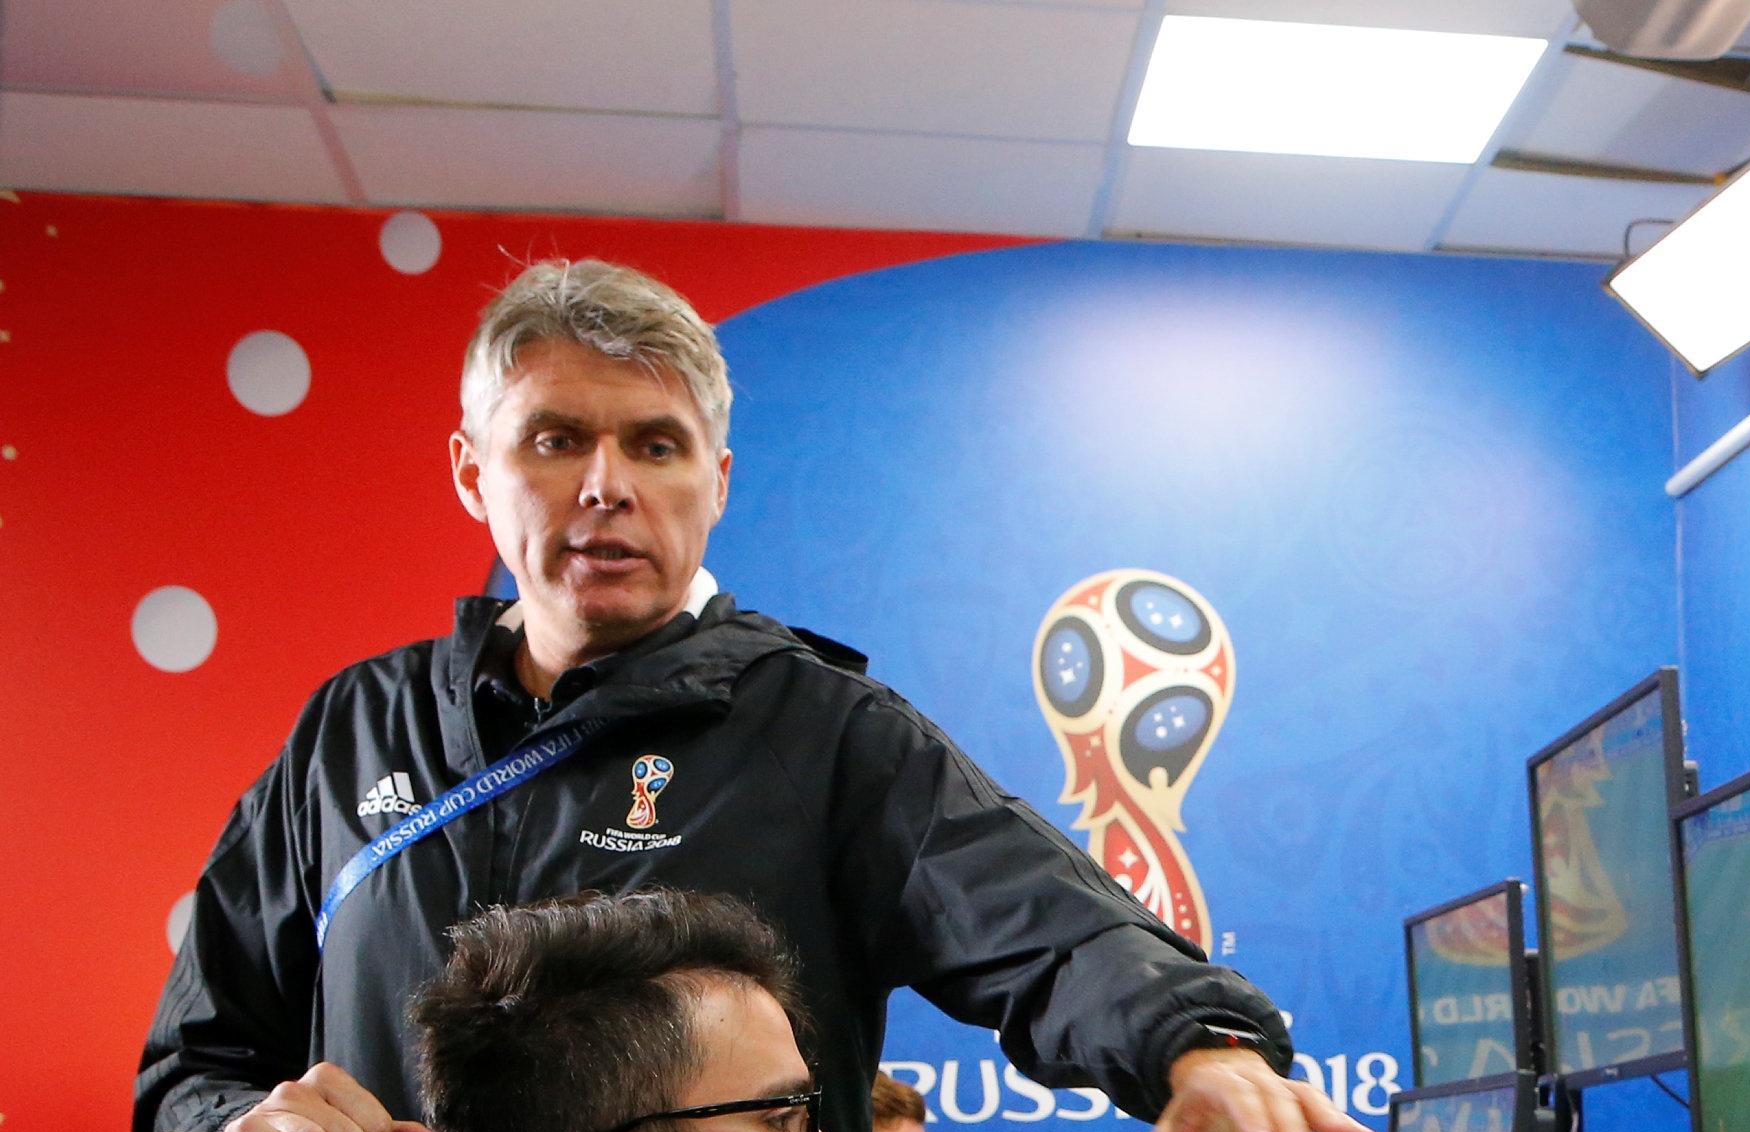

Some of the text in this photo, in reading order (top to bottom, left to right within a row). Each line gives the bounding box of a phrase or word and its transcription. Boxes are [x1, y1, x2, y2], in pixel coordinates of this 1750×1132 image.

[476, 749, 544, 794] WORLD
[357, 794, 423, 818] adidas
[440, 787, 476, 817] CUP
[372, 809, 437, 857] RUSSIA
[580, 830, 682, 853] RUSSIA 2018
[606, 827, 623, 839] FIFA
[624, 832, 650, 841] WORLD
